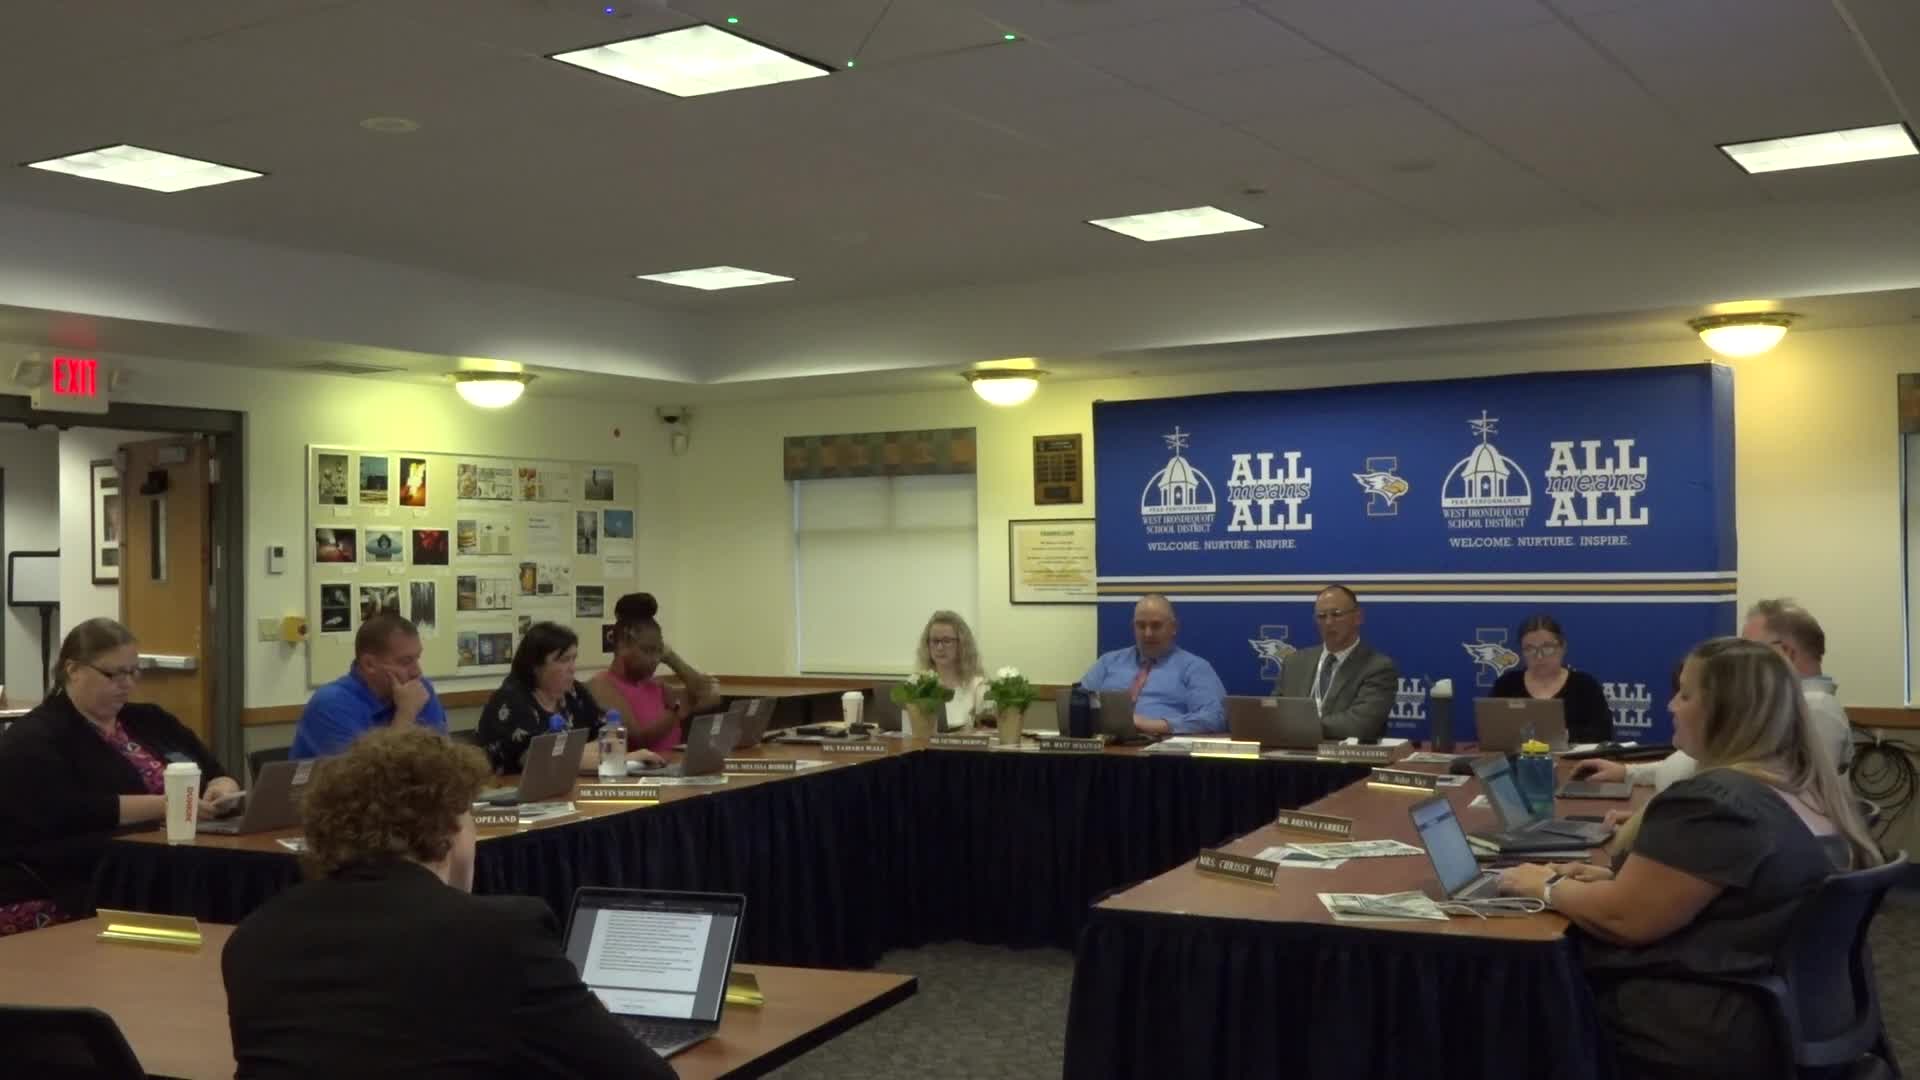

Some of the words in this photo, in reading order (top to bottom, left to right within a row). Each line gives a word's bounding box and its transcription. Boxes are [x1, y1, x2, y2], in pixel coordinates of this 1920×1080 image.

[53, 357, 97, 396] EXIT
[1545, 439, 1648, 476] ALL
[1227, 451, 1312, 486] ALL
[1228, 483, 1311, 502] means
[1546, 473, 1646, 493] means
[1227, 498, 1312, 532] ALL
[1442, 508, 1466, 518] WEST
[1469, 507, 1530, 518] IRONDEQUOIT
[1546, 490, 1649, 527] ALL
[1142, 515, 1162, 525] WEST
[1146, 525, 1175, 535] SCHOOL
[1177, 523, 1212, 533] DISTRICT
[1447, 518, 1483, 528] SCHOOL
[1485, 517, 1526, 528] DISTRICT
[1255, 539, 1297, 550] INSPIRE.
[1449, 537, 1514, 548] WELCOME.
[1517, 536, 1576, 547] NURTURE.
[1579, 535, 1632, 546] INSPIRE.
[472, 815, 517, 825] OPELAND
[1199, 854, 1216, 866] MRS.
[1219, 859, 1251, 873] CHRISSY
